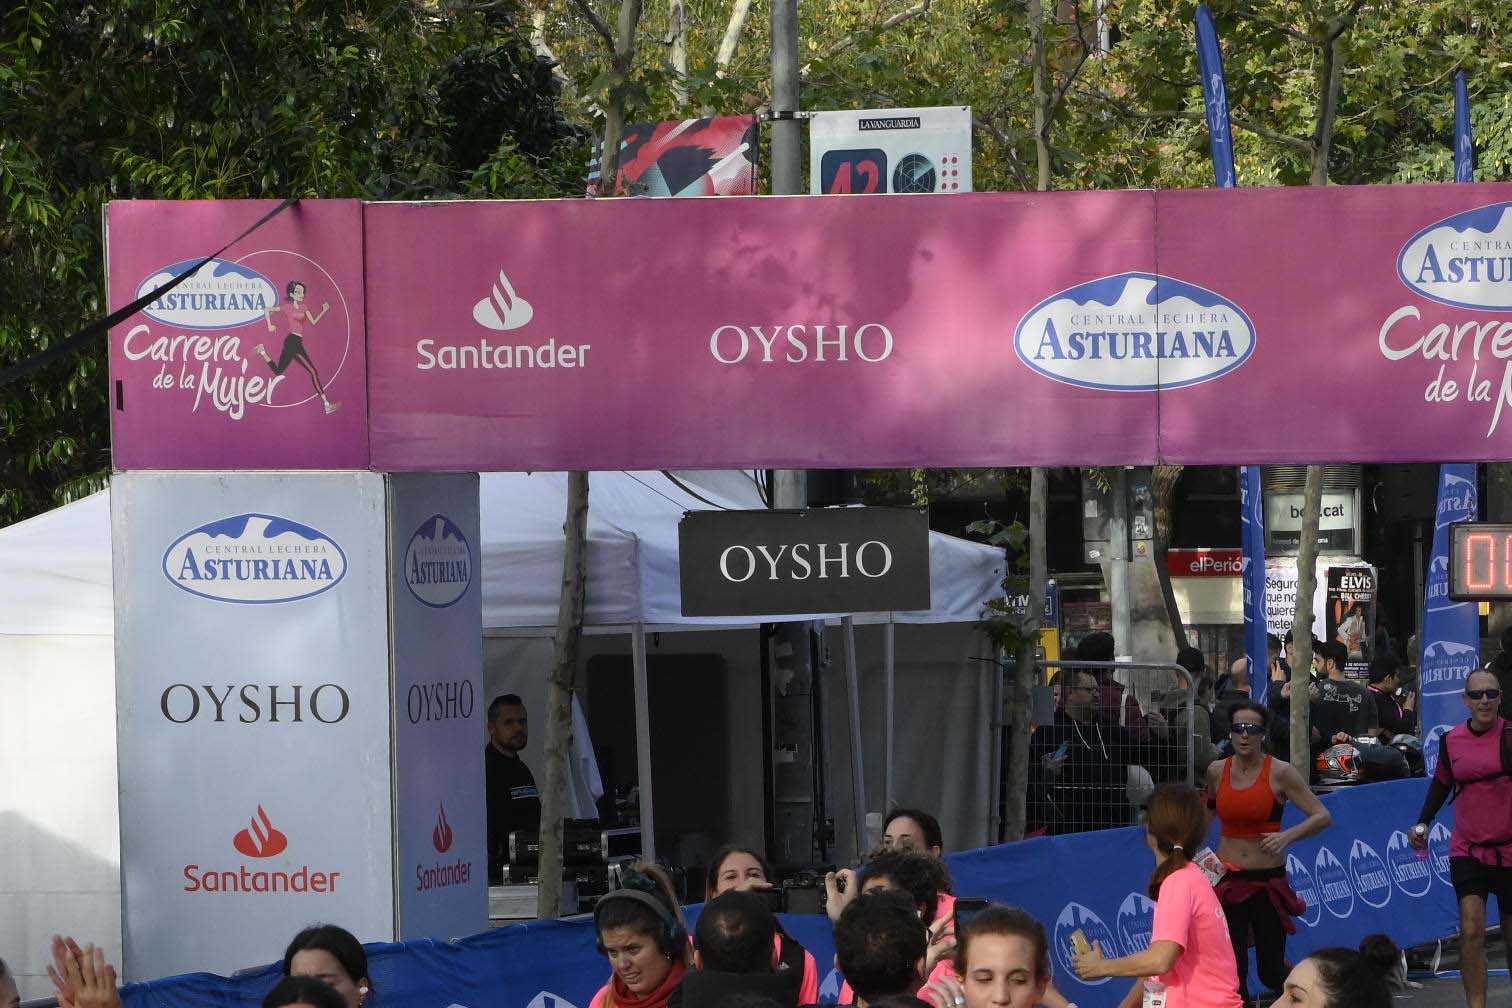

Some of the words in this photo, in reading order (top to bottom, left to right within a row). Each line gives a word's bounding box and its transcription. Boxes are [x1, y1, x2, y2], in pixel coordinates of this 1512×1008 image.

[148, 284, 267, 311] ASTURIANA
[172, 281, 219, 290] ENTRAL
[223, 281, 263, 290] LECHERA
[1070, 314, 1144, 326] CENTRAL
[1153, 311, 1231, 324] LECHERA
[123, 324, 241, 361] Carrera
[417, 337, 591, 371] Santander
[710, 323, 894, 365] OYSHO
[1034, 318, 1237, 361] ASTURIANA
[153, 364, 174, 389] de
[180, 364, 195, 389] la
[192, 358, 286, 420] Mujer
[1425, 364, 1459, 402] de
[1467, 360, 1491, 402] la
[178, 547, 334, 581] ASTURIANA
[205, 545, 263, 555] CENTRAL
[269, 545, 327, 554] LECHERA
[719, 540, 893, 583] OYSHO
[410, 557, 468, 586] ASTURIANA
[1341, 576, 1372, 589] ELVIS
[160, 683, 350, 724] OYSHO
[408, 679, 474, 724] OYSHO
[183, 865, 340, 893] Santander
[416, 861, 472, 892] Santander
